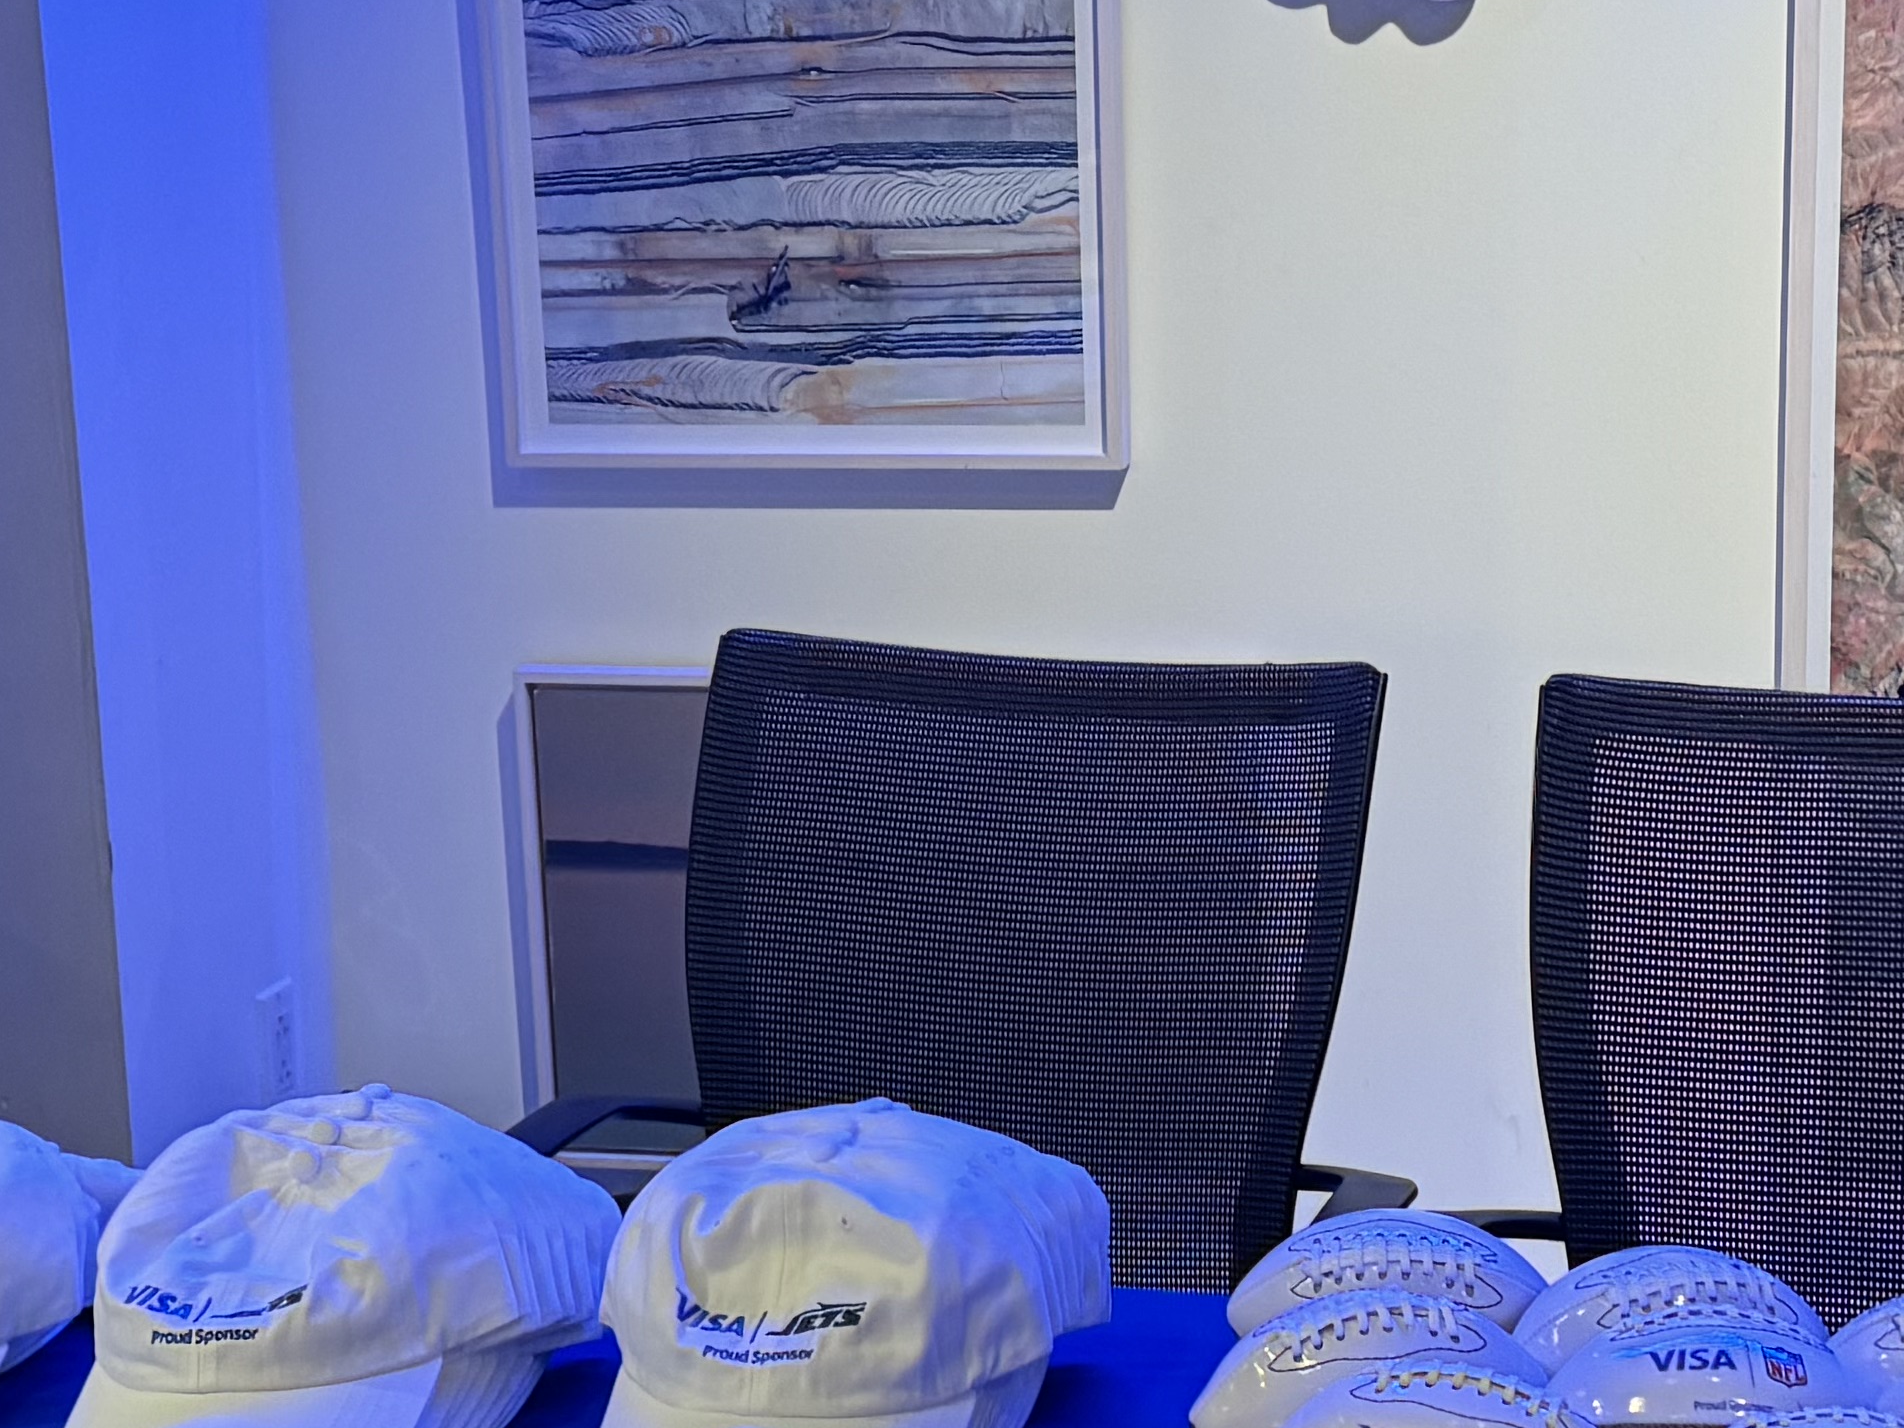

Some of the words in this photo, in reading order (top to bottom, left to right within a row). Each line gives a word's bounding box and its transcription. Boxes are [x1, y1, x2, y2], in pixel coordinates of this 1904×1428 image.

[124, 1284, 194, 1320] VISA
[675, 1286, 746, 1338] VISA
[150, 1328, 192, 1346] Proud
[195, 1328, 260, 1346] Sponsor
[702, 1344, 749, 1364] Proud
[751, 1348, 815, 1366] Sponsor
[1648, 1348, 1738, 1372] VISA
